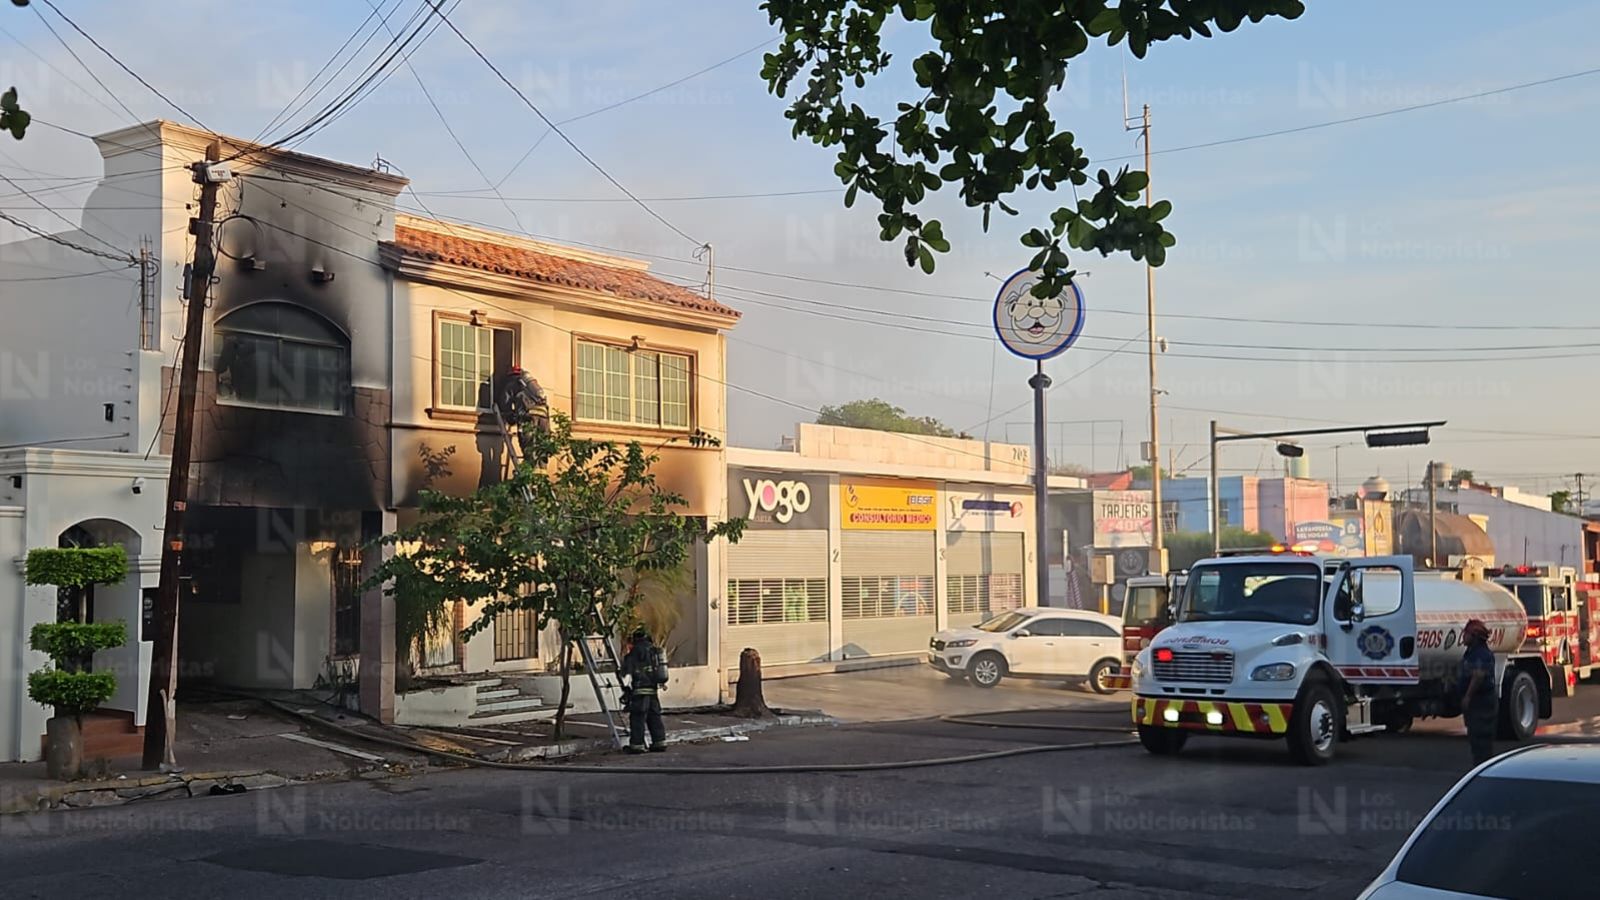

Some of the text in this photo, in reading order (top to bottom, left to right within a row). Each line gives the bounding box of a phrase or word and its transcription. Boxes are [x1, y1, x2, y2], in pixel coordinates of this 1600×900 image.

[743, 478, 811, 524] yogo
[1101, 504, 1149, 519] TARJETAS
[833, 548, 840, 563] 2
[1416, 629, 1443, 649] EROS
